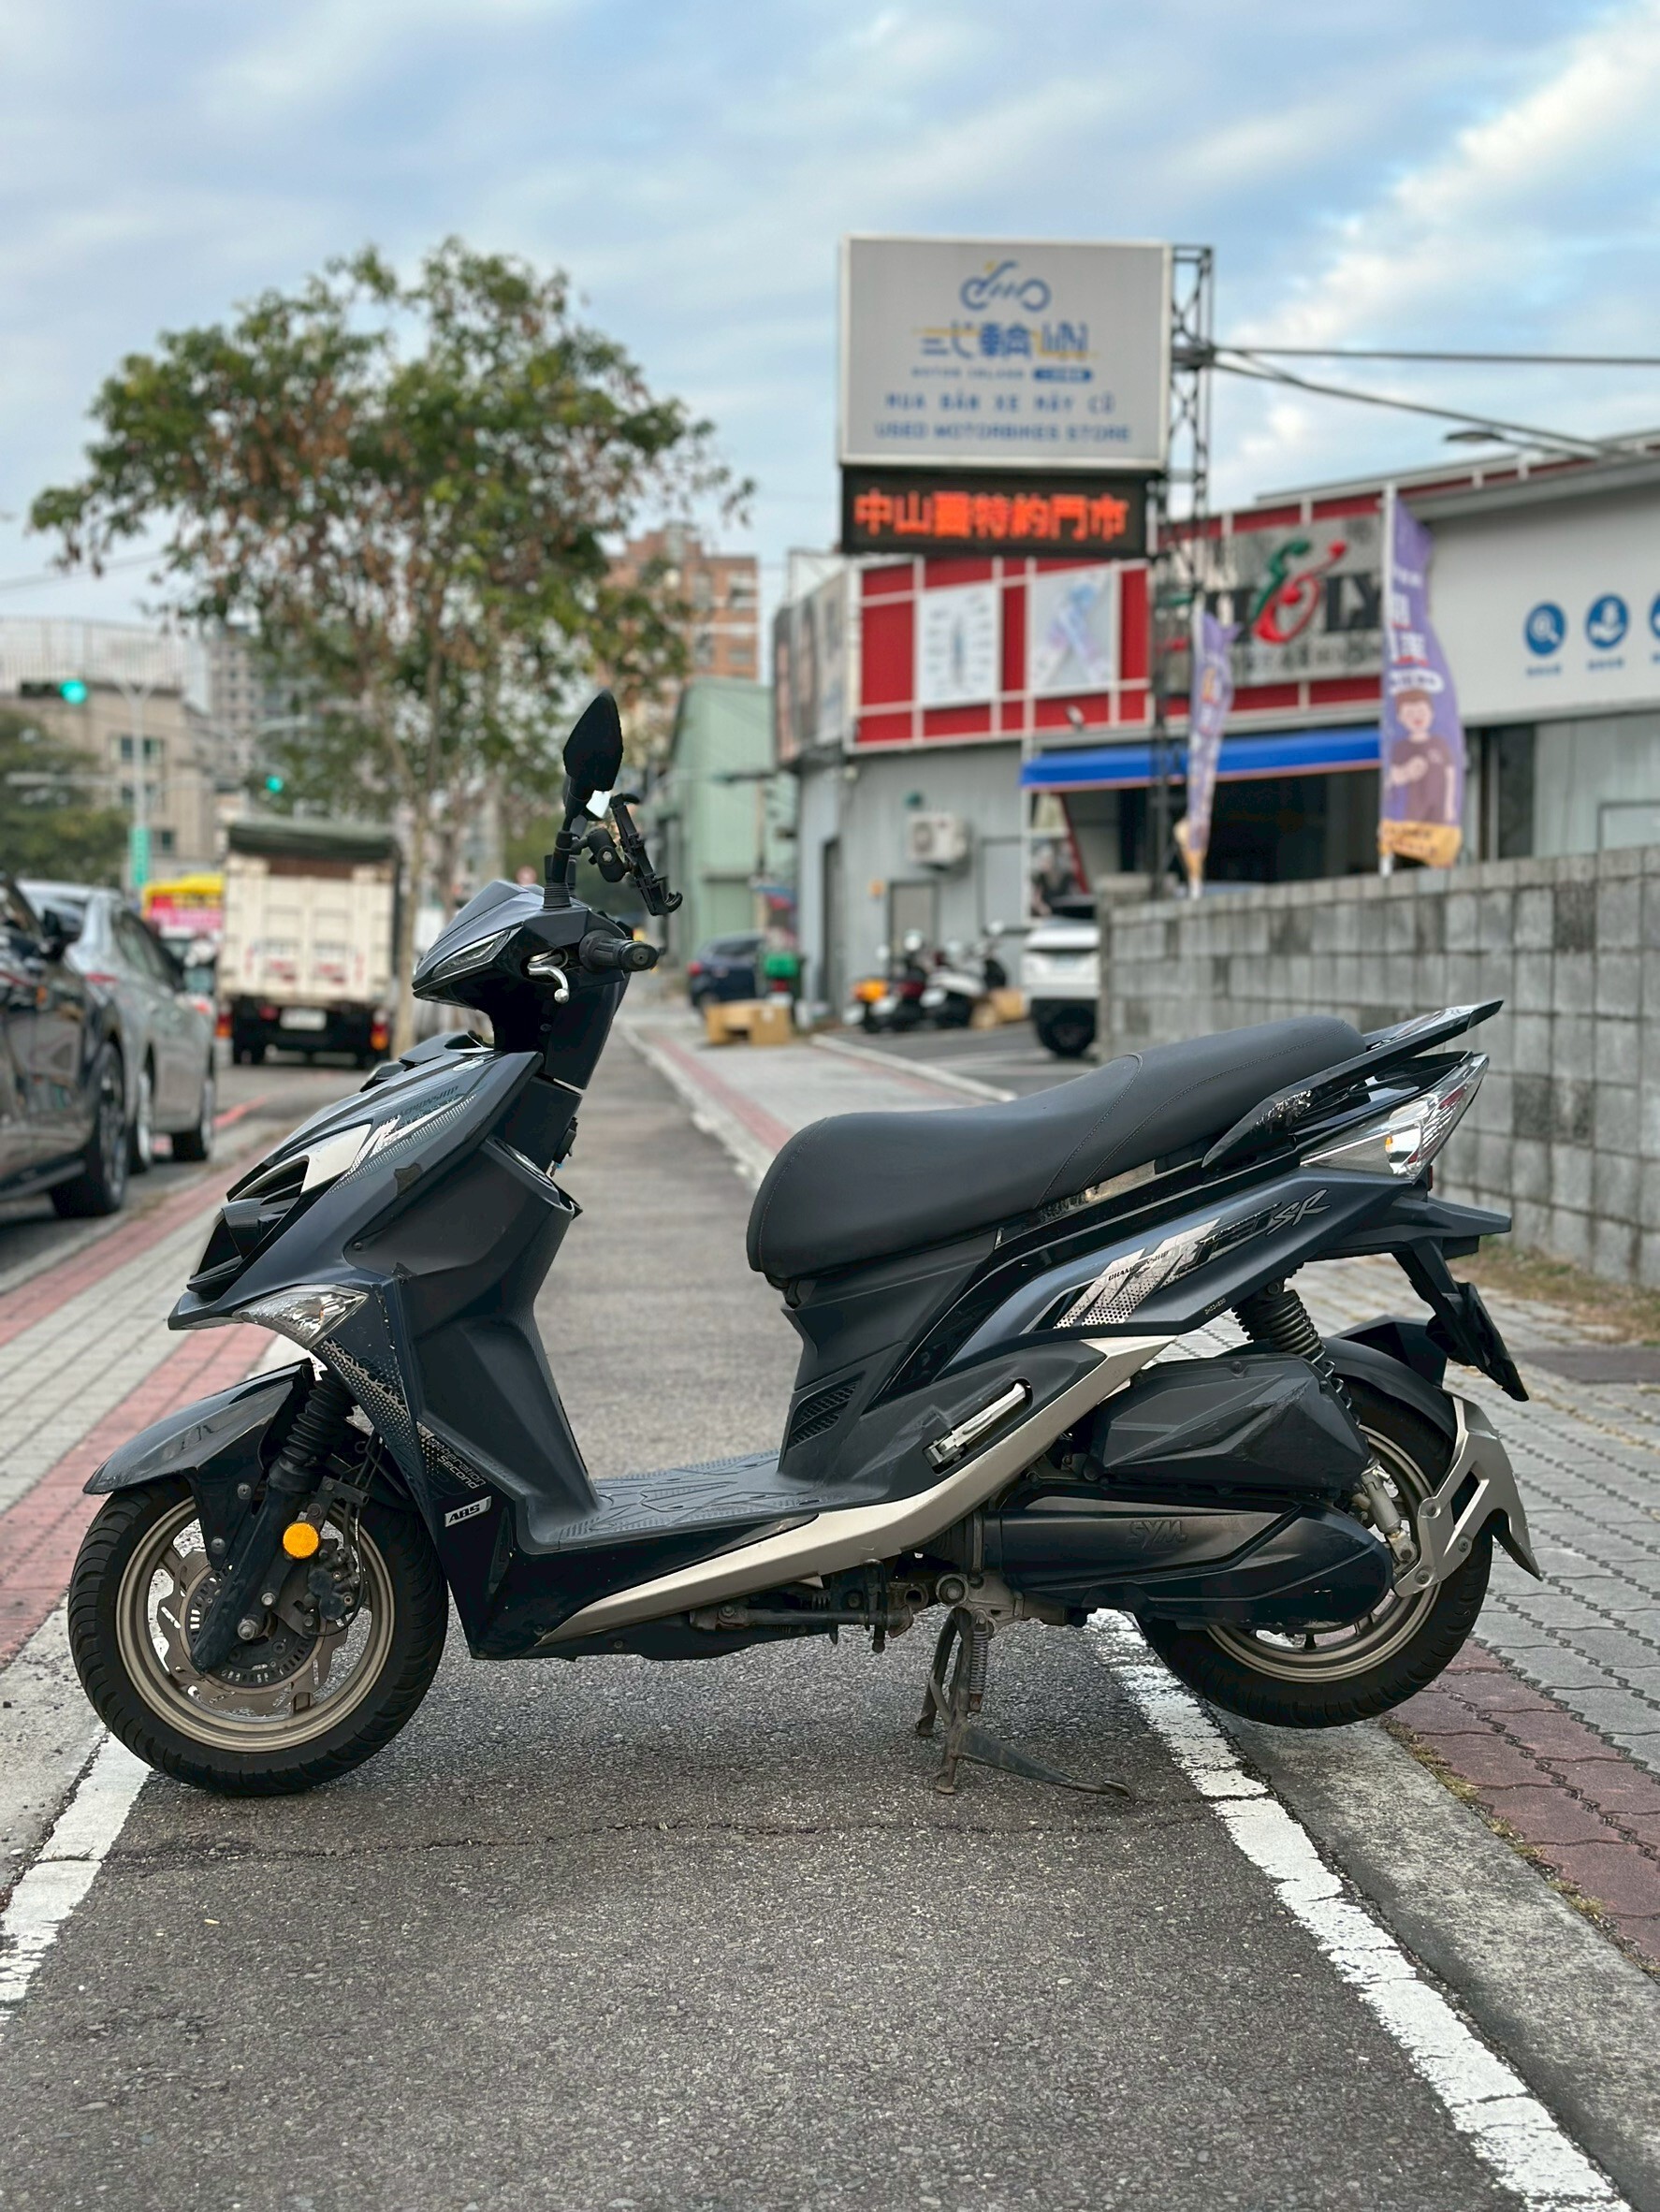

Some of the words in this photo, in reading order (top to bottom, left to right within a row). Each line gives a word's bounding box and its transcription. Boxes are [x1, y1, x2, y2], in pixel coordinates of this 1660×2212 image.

[1108, 1249, 1170, 1282] CHAMPNSHIP
[448, 1504, 481, 1523] ABS
[1127, 1519, 1186, 1547] SYM
